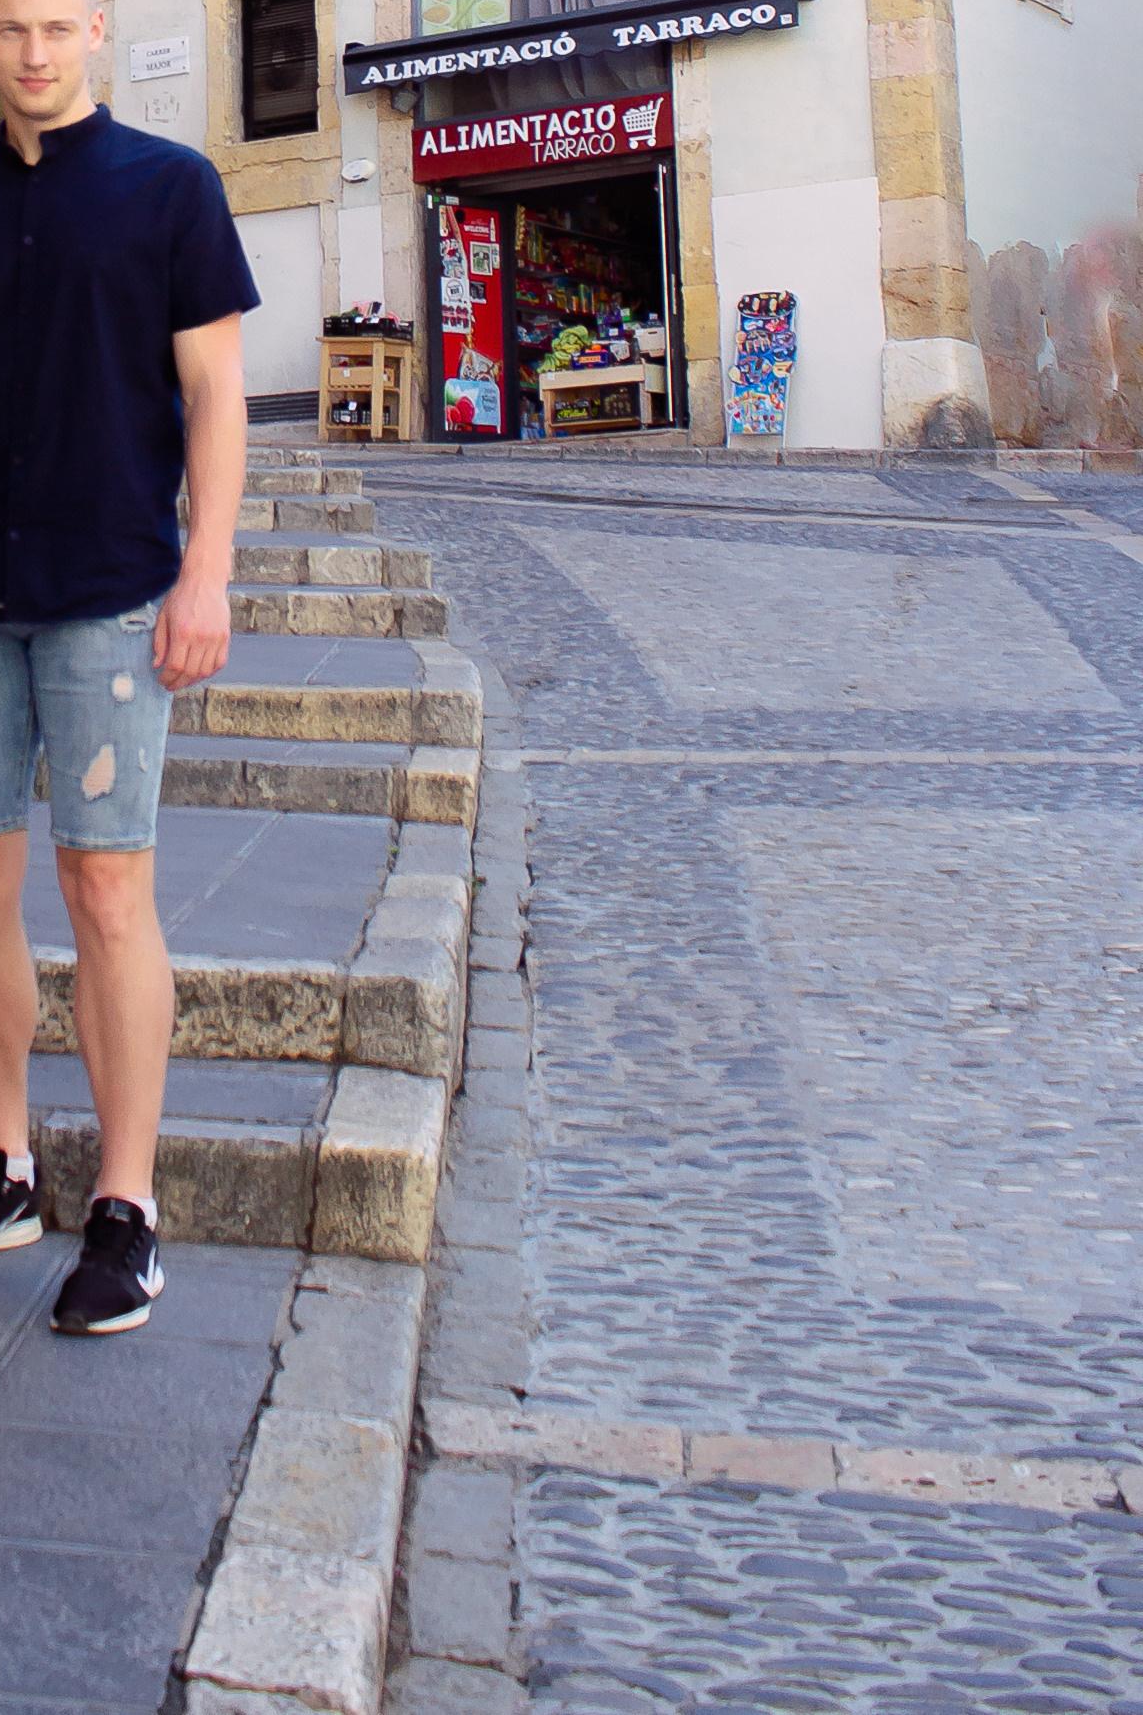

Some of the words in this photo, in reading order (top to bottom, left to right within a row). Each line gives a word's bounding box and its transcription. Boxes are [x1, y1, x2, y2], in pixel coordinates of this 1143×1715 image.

[361, 31, 577, 85] ALIMENTACIÓ
[612, 4, 777, 47] TARRACO
[146, 60, 172, 71] MAJOR
[530, 132, 616, 163] TARRACO
